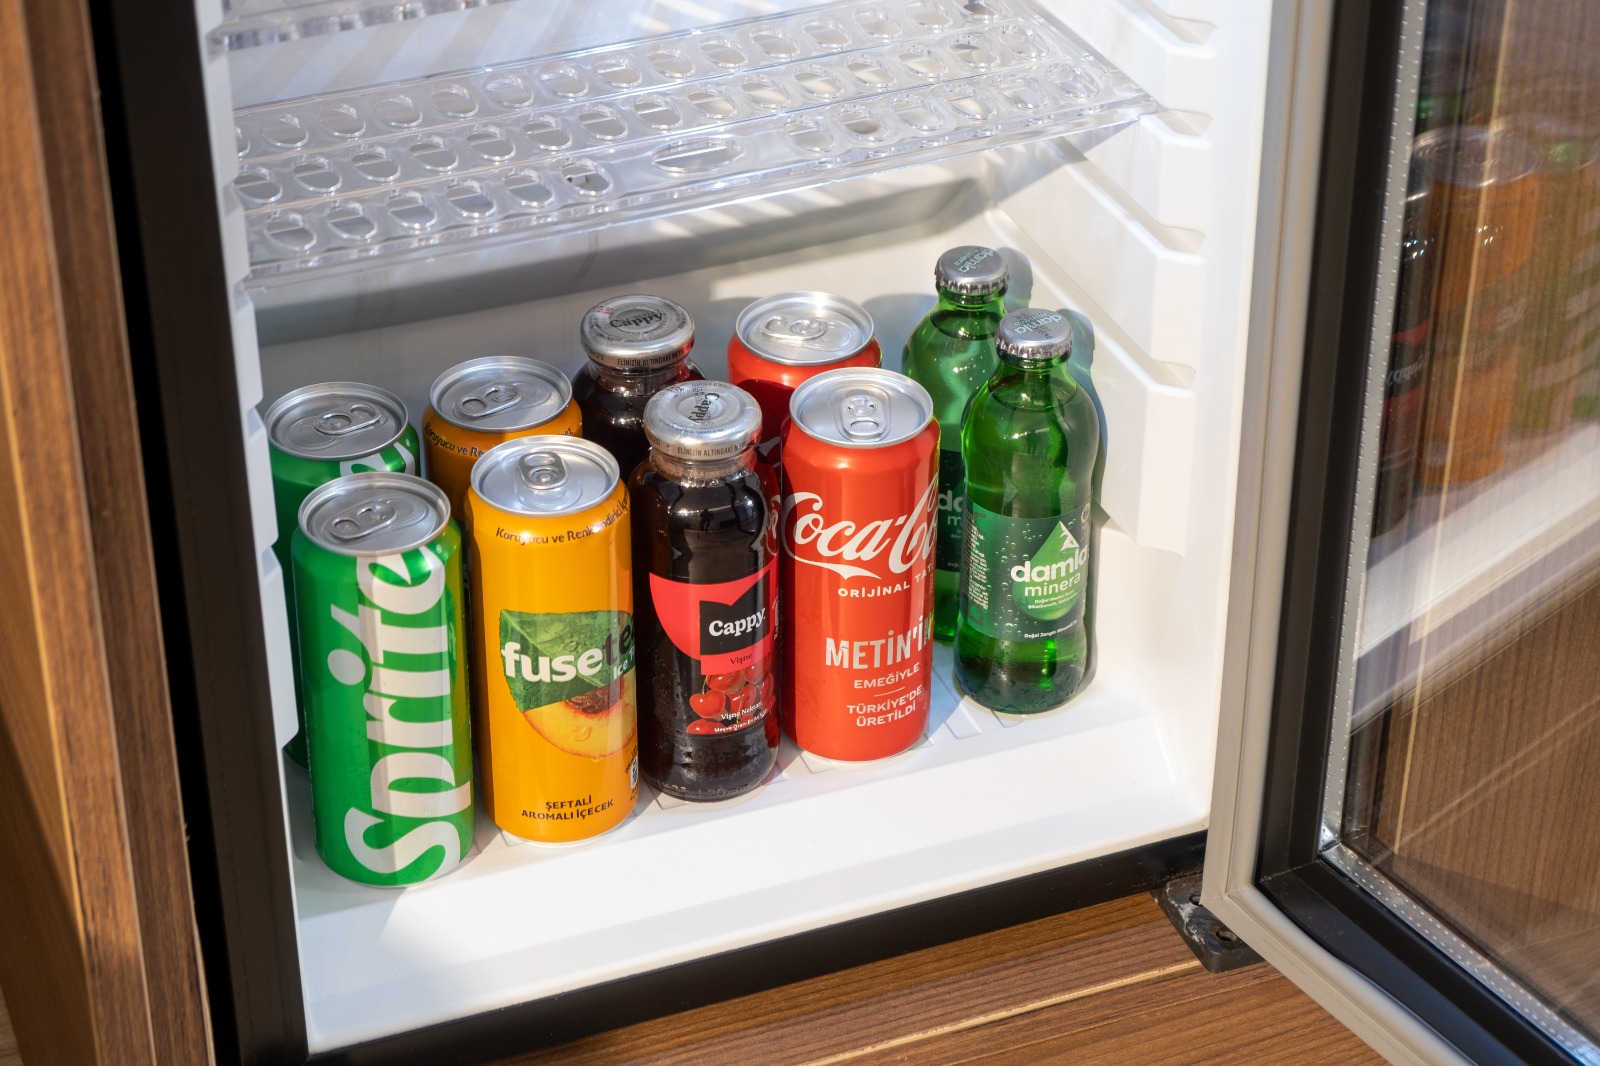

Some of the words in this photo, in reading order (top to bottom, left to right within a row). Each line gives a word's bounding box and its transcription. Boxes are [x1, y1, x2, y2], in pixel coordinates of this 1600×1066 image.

[609, 310, 663, 328] Cappy
[1015, 314, 1063, 335] damla
[688, 393, 720, 424] Cappy
[424, 422, 455, 451] Koruyucu
[457, 446, 468, 455] ve
[496, 527, 549, 545] Koruyucu
[551, 535, 564, 543] ve
[1010, 544, 1088, 582] damla
[837, 581, 910, 598] ORİJİNAL
[1024, 572, 1081, 597] minera
[708, 607, 766, 637] Cappy
[501, 624, 634, 682] fusete
[854, 662, 920, 689] EMEĞİYLE
[847, 684, 922, 714] TÜRKİYE'DE
[328, 545, 471, 882] Sprite
[856, 699, 916, 727] ÜRETİLDİ
[521, 809, 574, 820] AROMALI
[576, 798, 614, 819] İÇECEK
[545, 795, 592, 811] ŞEFTALİ
